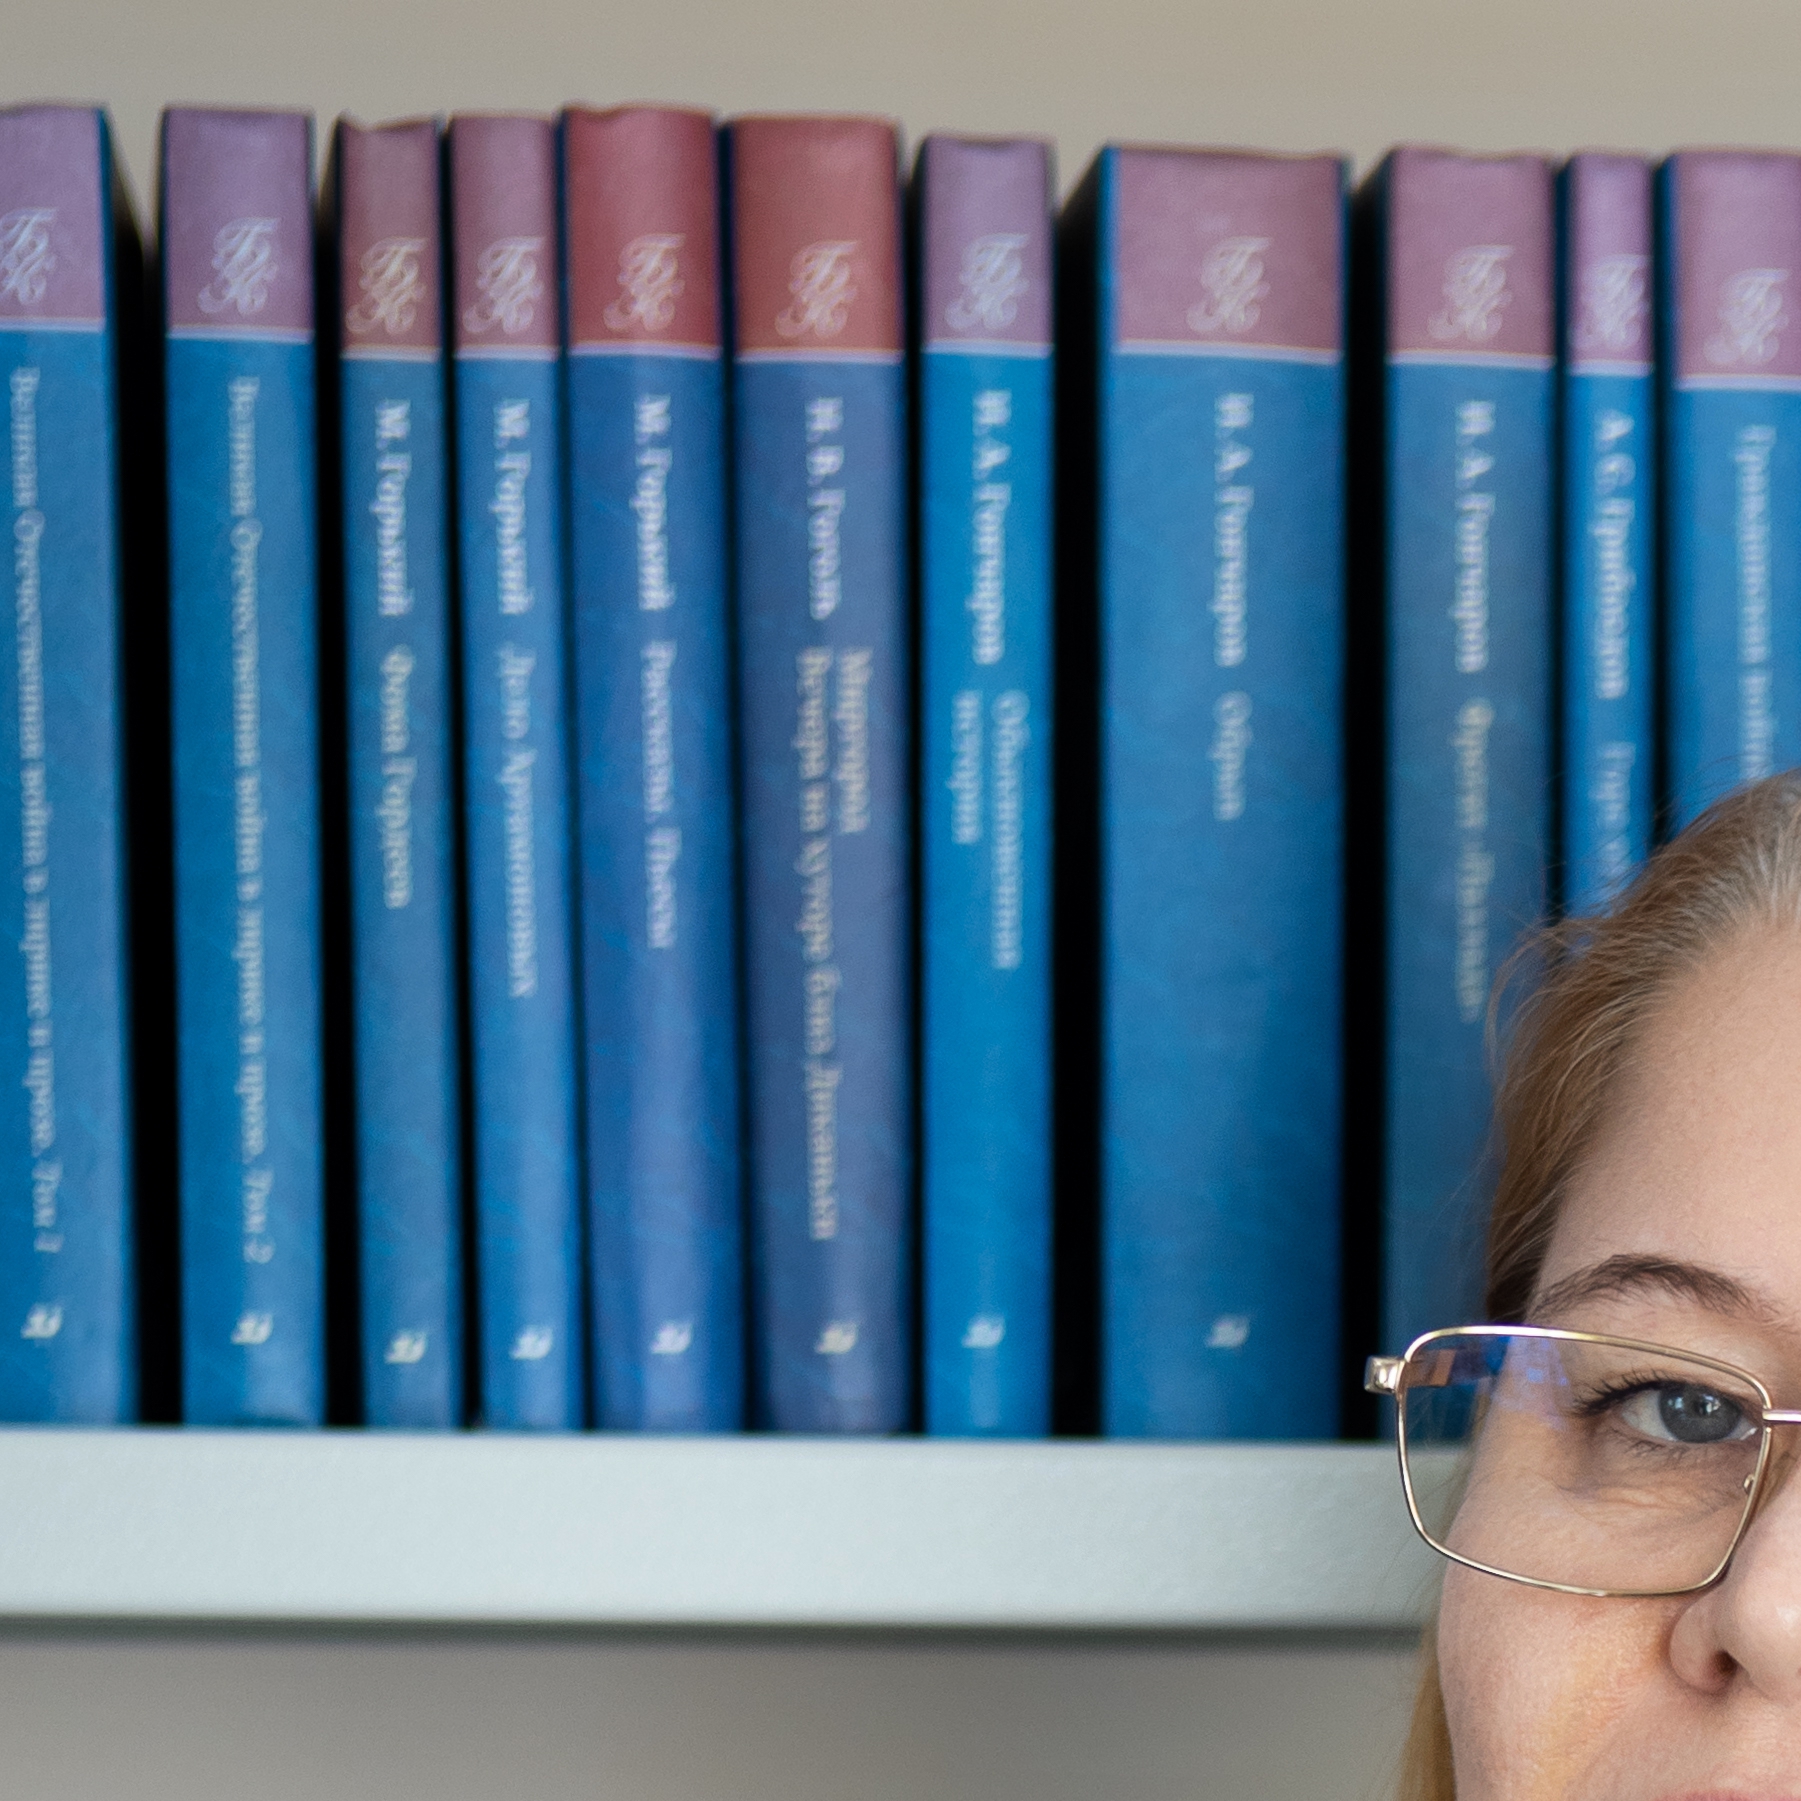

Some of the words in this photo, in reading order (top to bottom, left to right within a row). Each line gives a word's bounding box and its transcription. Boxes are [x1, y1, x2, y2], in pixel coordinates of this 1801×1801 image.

[374, 401, 410, 449] М.
[493, 401, 528, 448] М.
[372, 453, 415, 616] Горький
[491, 453, 534, 615] Горький
[377, 646, 412, 752] Фома
[496, 645, 535, 744] Дело
[375, 757, 416, 910] Гордеев
[498, 749, 538, 999] Артамоновых
